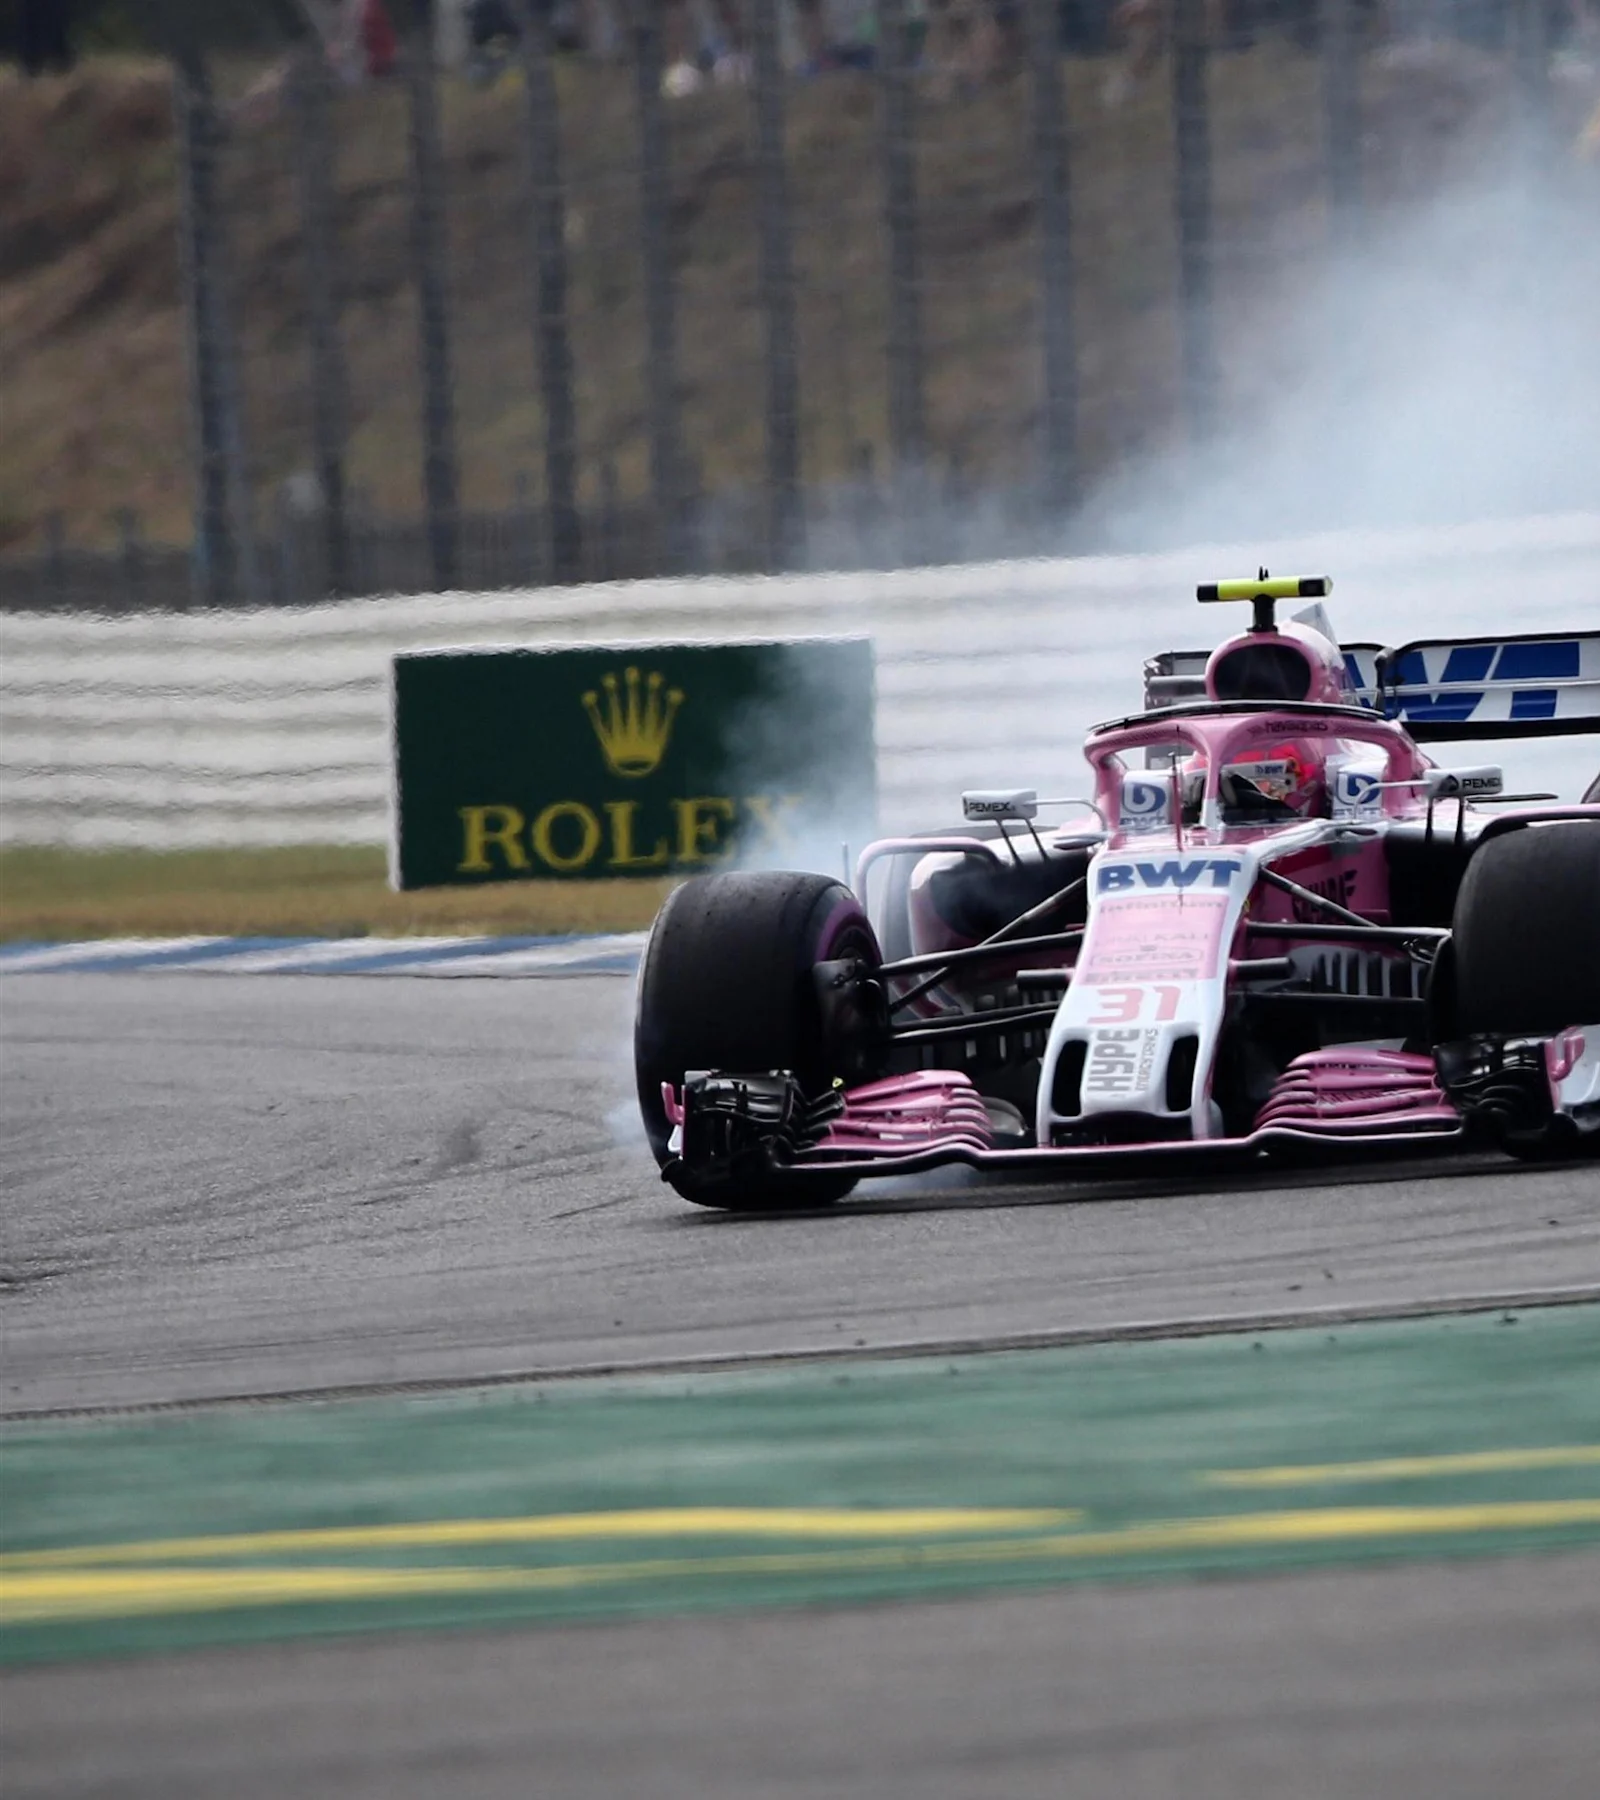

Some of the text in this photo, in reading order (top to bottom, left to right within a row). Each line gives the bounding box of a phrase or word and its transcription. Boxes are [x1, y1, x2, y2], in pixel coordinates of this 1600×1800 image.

[1343, 641, 1580, 721] WT
[969, 802, 1010, 812] PEMEX
[1098, 859, 1241, 894] BWT
[1087, 986, 1181, 1024] 31
[1087, 1029, 1141, 1091] HYPE
